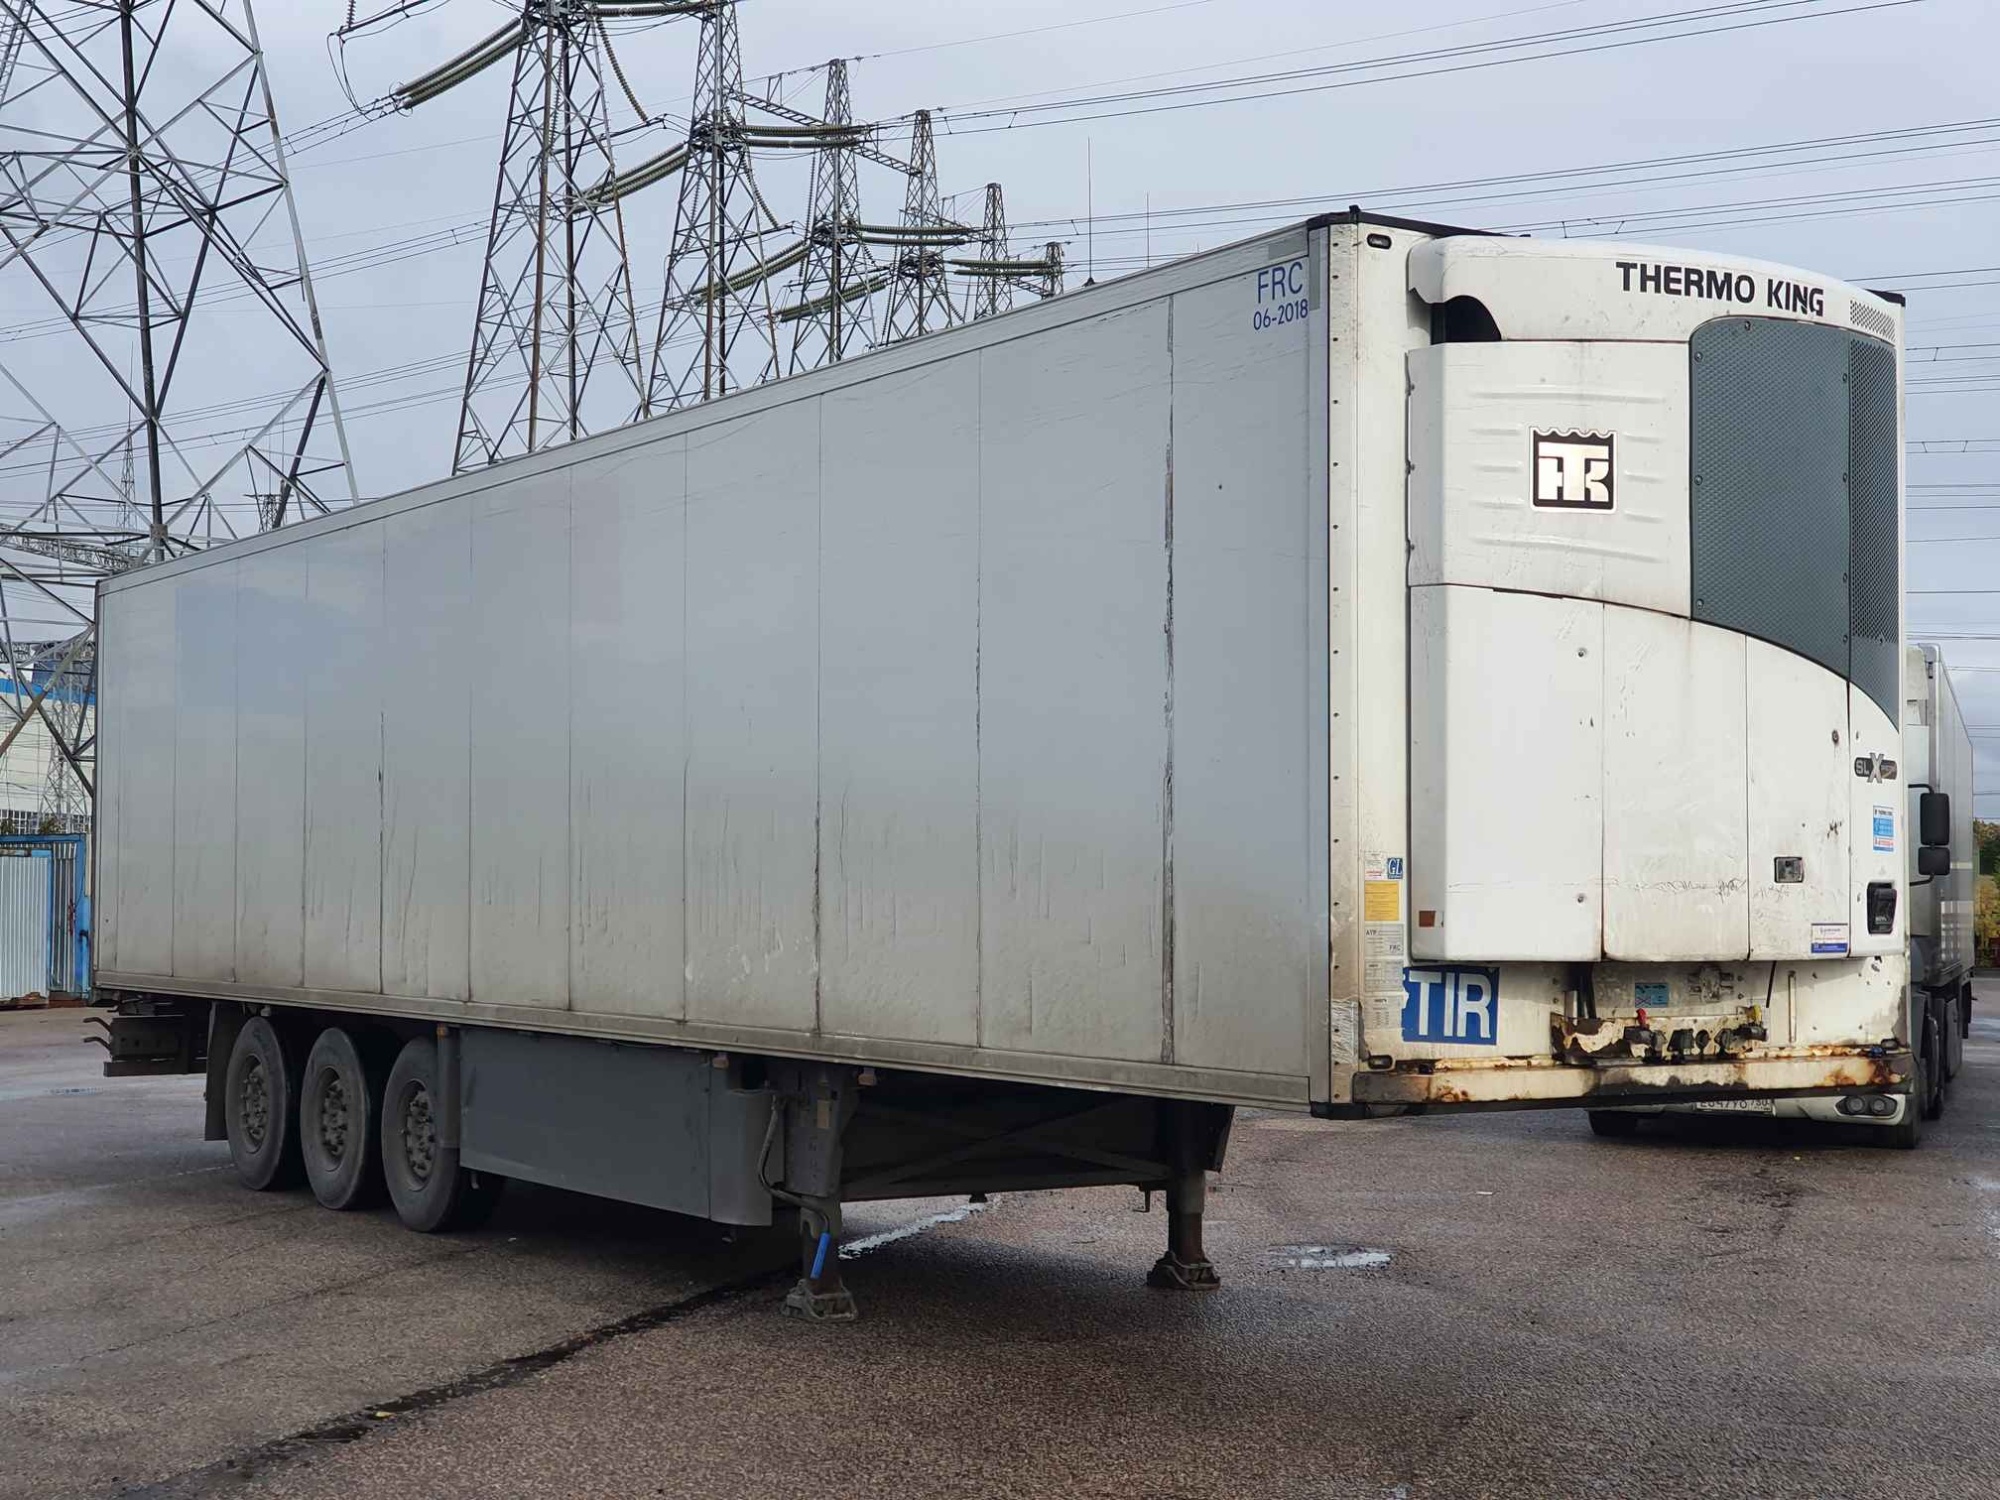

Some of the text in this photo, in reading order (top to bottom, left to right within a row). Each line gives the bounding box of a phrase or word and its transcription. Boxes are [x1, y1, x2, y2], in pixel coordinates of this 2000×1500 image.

[1257, 262, 1303, 304] FRC
[1615, 261, 1824, 317] THERMO KING
[1253, 298, 1309, 331] 06-2018
[1408, 969, 1492, 1039] TIR
